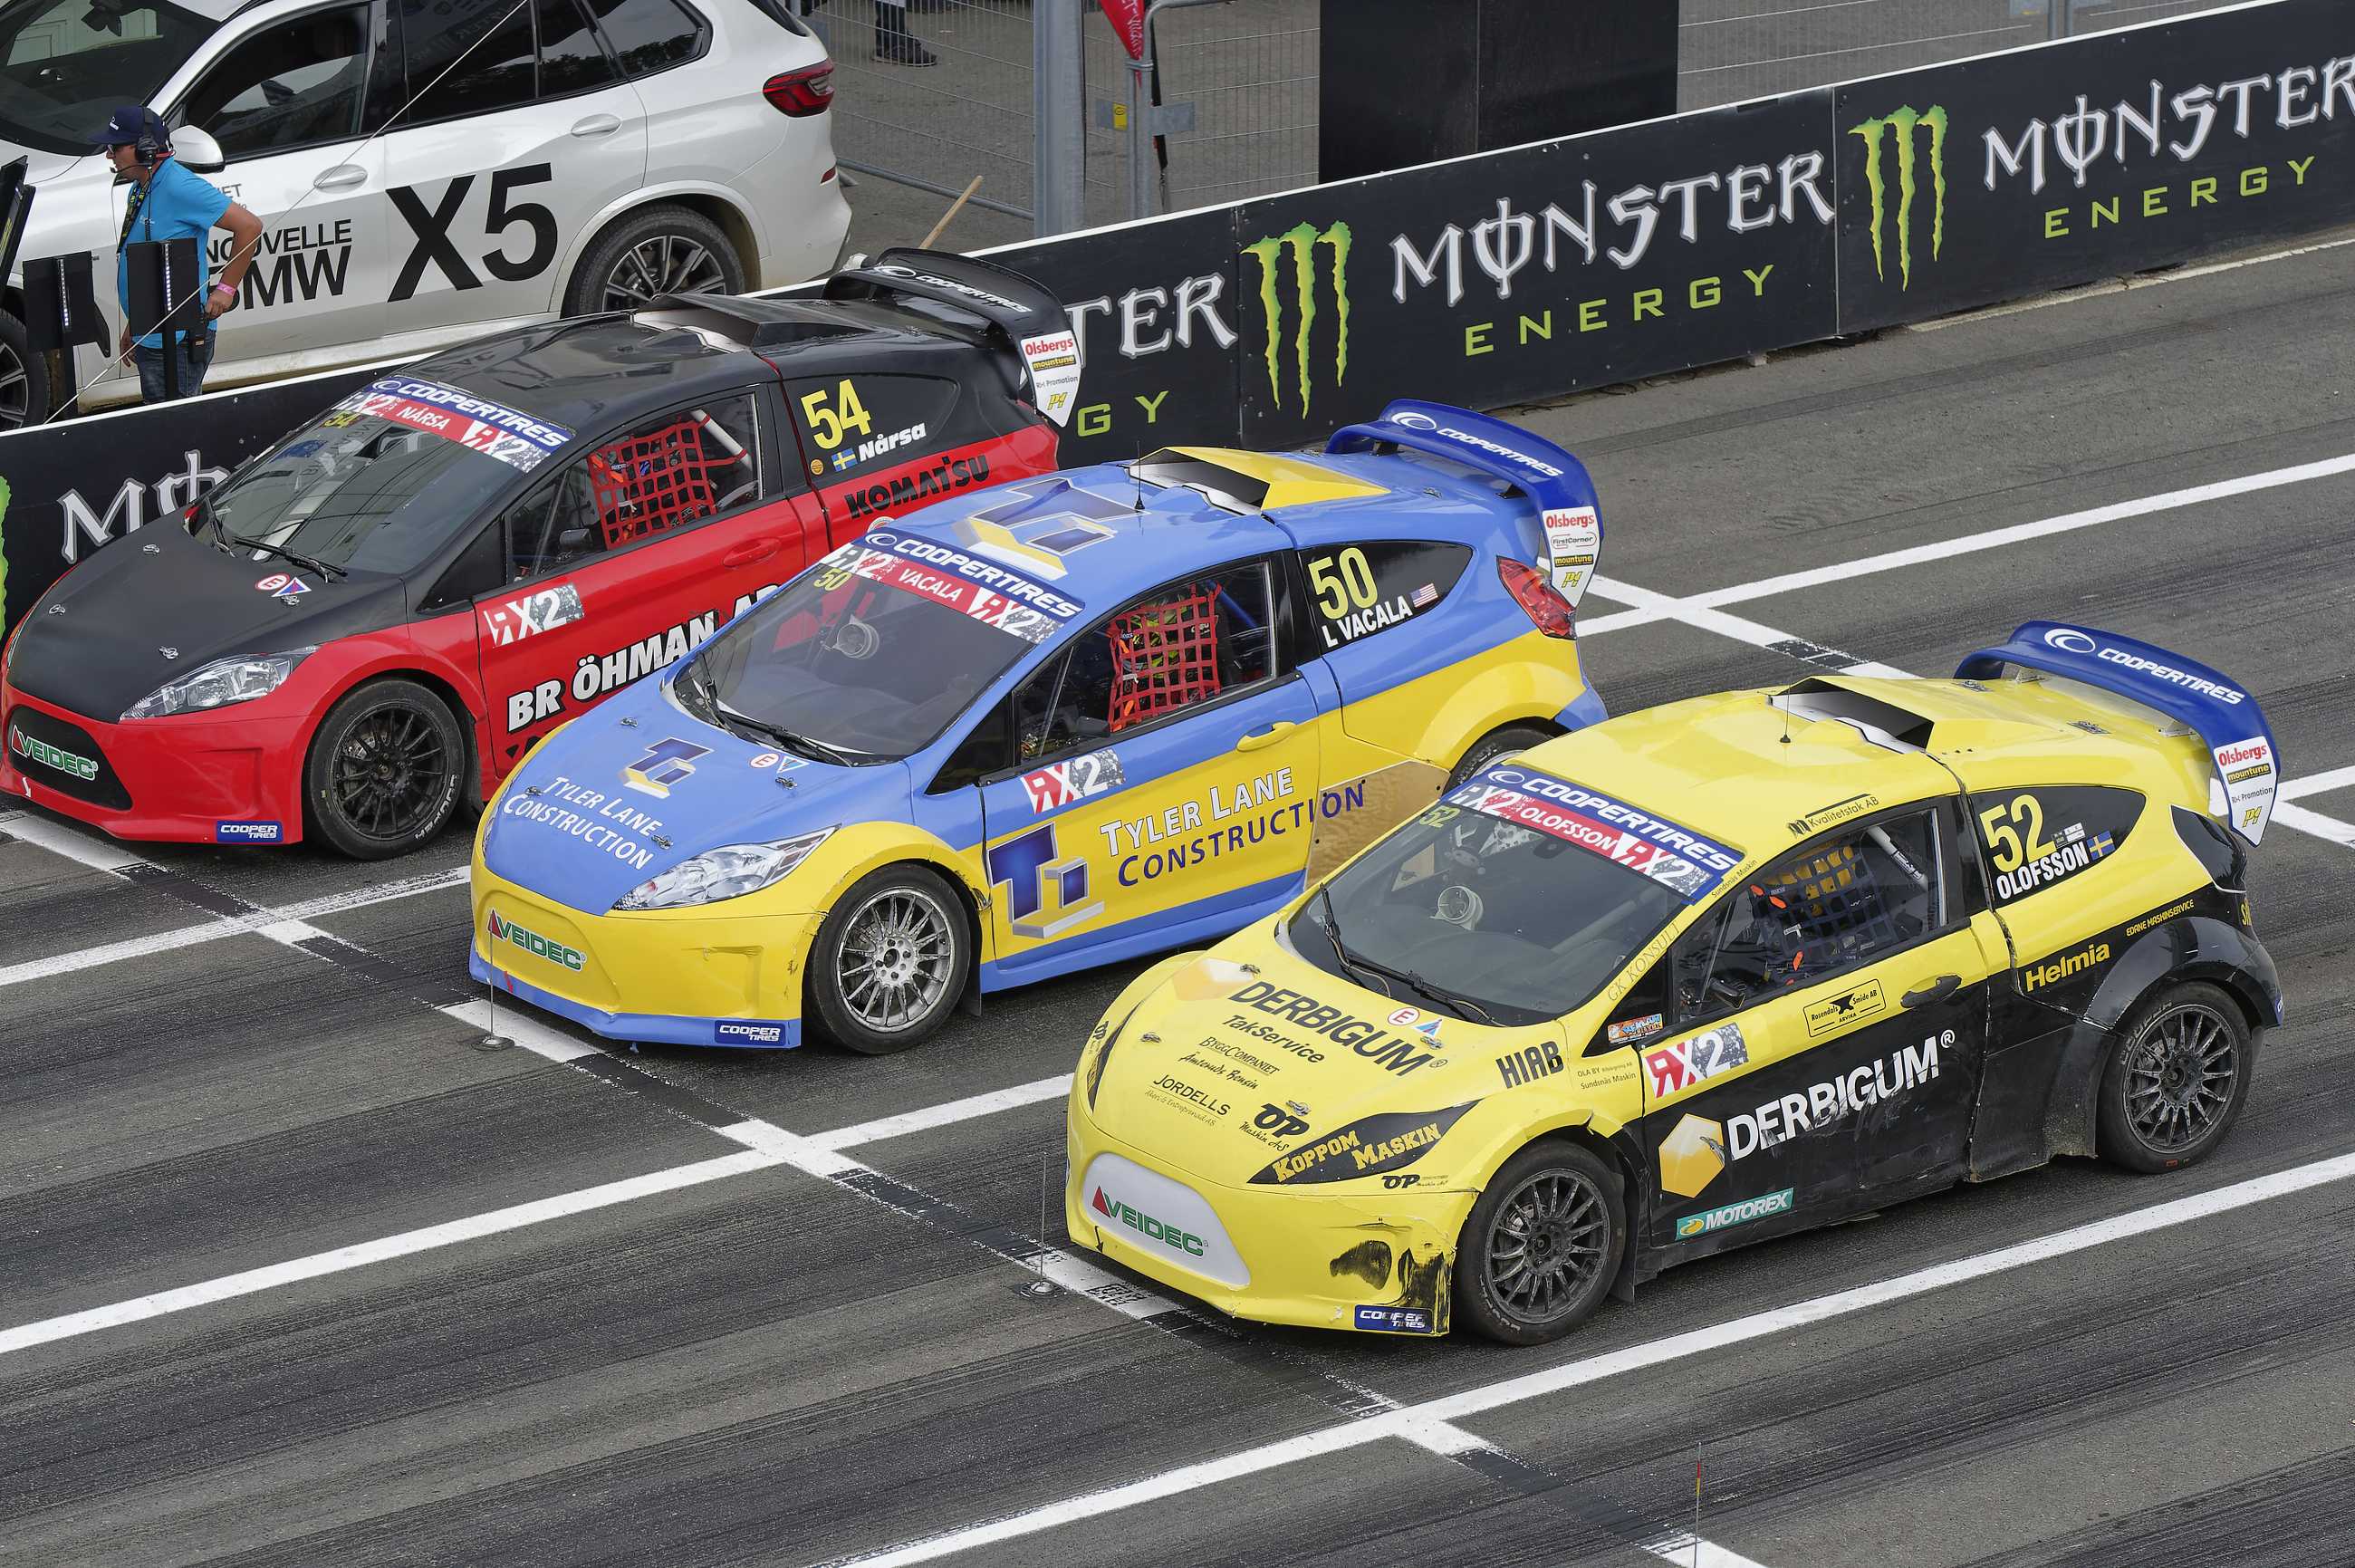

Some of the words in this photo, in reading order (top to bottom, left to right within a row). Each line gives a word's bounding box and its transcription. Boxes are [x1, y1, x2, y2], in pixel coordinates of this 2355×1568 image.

[2044, 156, 2315, 239] ENERGY
[385, 162, 558, 303] X5
[1389, 149, 1835, 308] MONSTER
[1465, 265, 1773, 357] ENERGY
[1024, 336, 1074, 356] Olsbergs
[1046, 375, 1078, 386] Promotion
[398, 382, 570, 448] COOPERTIRES
[399, 406, 451, 429] NÅRSA
[801, 379, 871, 449] 54
[860, 422, 927, 462] Nårsa
[1437, 428, 1564, 476] COOPERTIRES
[844, 455, 990, 520] KOMATSU
[1546, 514, 1594, 529] Olsbergs
[813, 568, 852, 592] 50
[893, 539, 1084, 619] COOPERTIRES
[898, 567, 964, 602] VACALA
[1308, 547, 1378, 620] 50
[1322, 624, 1340, 648] L
[1336, 595, 1413, 641] VACALA
[509, 680, 562, 733] BR
[572, 610, 716, 701] ÖHMAN
[2097, 648, 2245, 705] COOPERTIRES
[2219, 745, 2267, 766] Olsbergs
[543, 776, 605, 809] TYLER
[599, 797, 663, 837] LANE
[1099, 799, 1203, 857] TYLER
[1209, 767, 1294, 821] LANE
[1808, 801, 1864, 828] Kvalitetstak
[1865, 796, 1879, 808] AB
[2241, 786, 2273, 800] Promotion
[220, 824, 278, 834] COOPER
[503, 794, 653, 870] CONSTRUCTION
[1118, 783, 1365, 887] CONSTRUCTION
[1520, 807, 1620, 851] OLOFSSON
[1522, 778, 1740, 872] COOPERTIRES
[1979, 794, 2057, 873] 52
[1736, 859, 1758, 880] Maskin
[1996, 841, 2090, 899] OLOFSSON
[2024, 942, 2111, 992] Helmia
[719, 1024, 781, 1035] COOPER
[1222, 1015, 1325, 1063] TakService
[1495, 1041, 1564, 1089] HIAB
[1612, 1073, 1636, 1082] Maskin
[1153, 1074, 1231, 1116] JORDELLS
[1272, 1130, 1361, 1183] KOPPOM
[1351, 1122, 1442, 1171] MASKIN
[1705, 1191, 1789, 1231] MOTOREX
